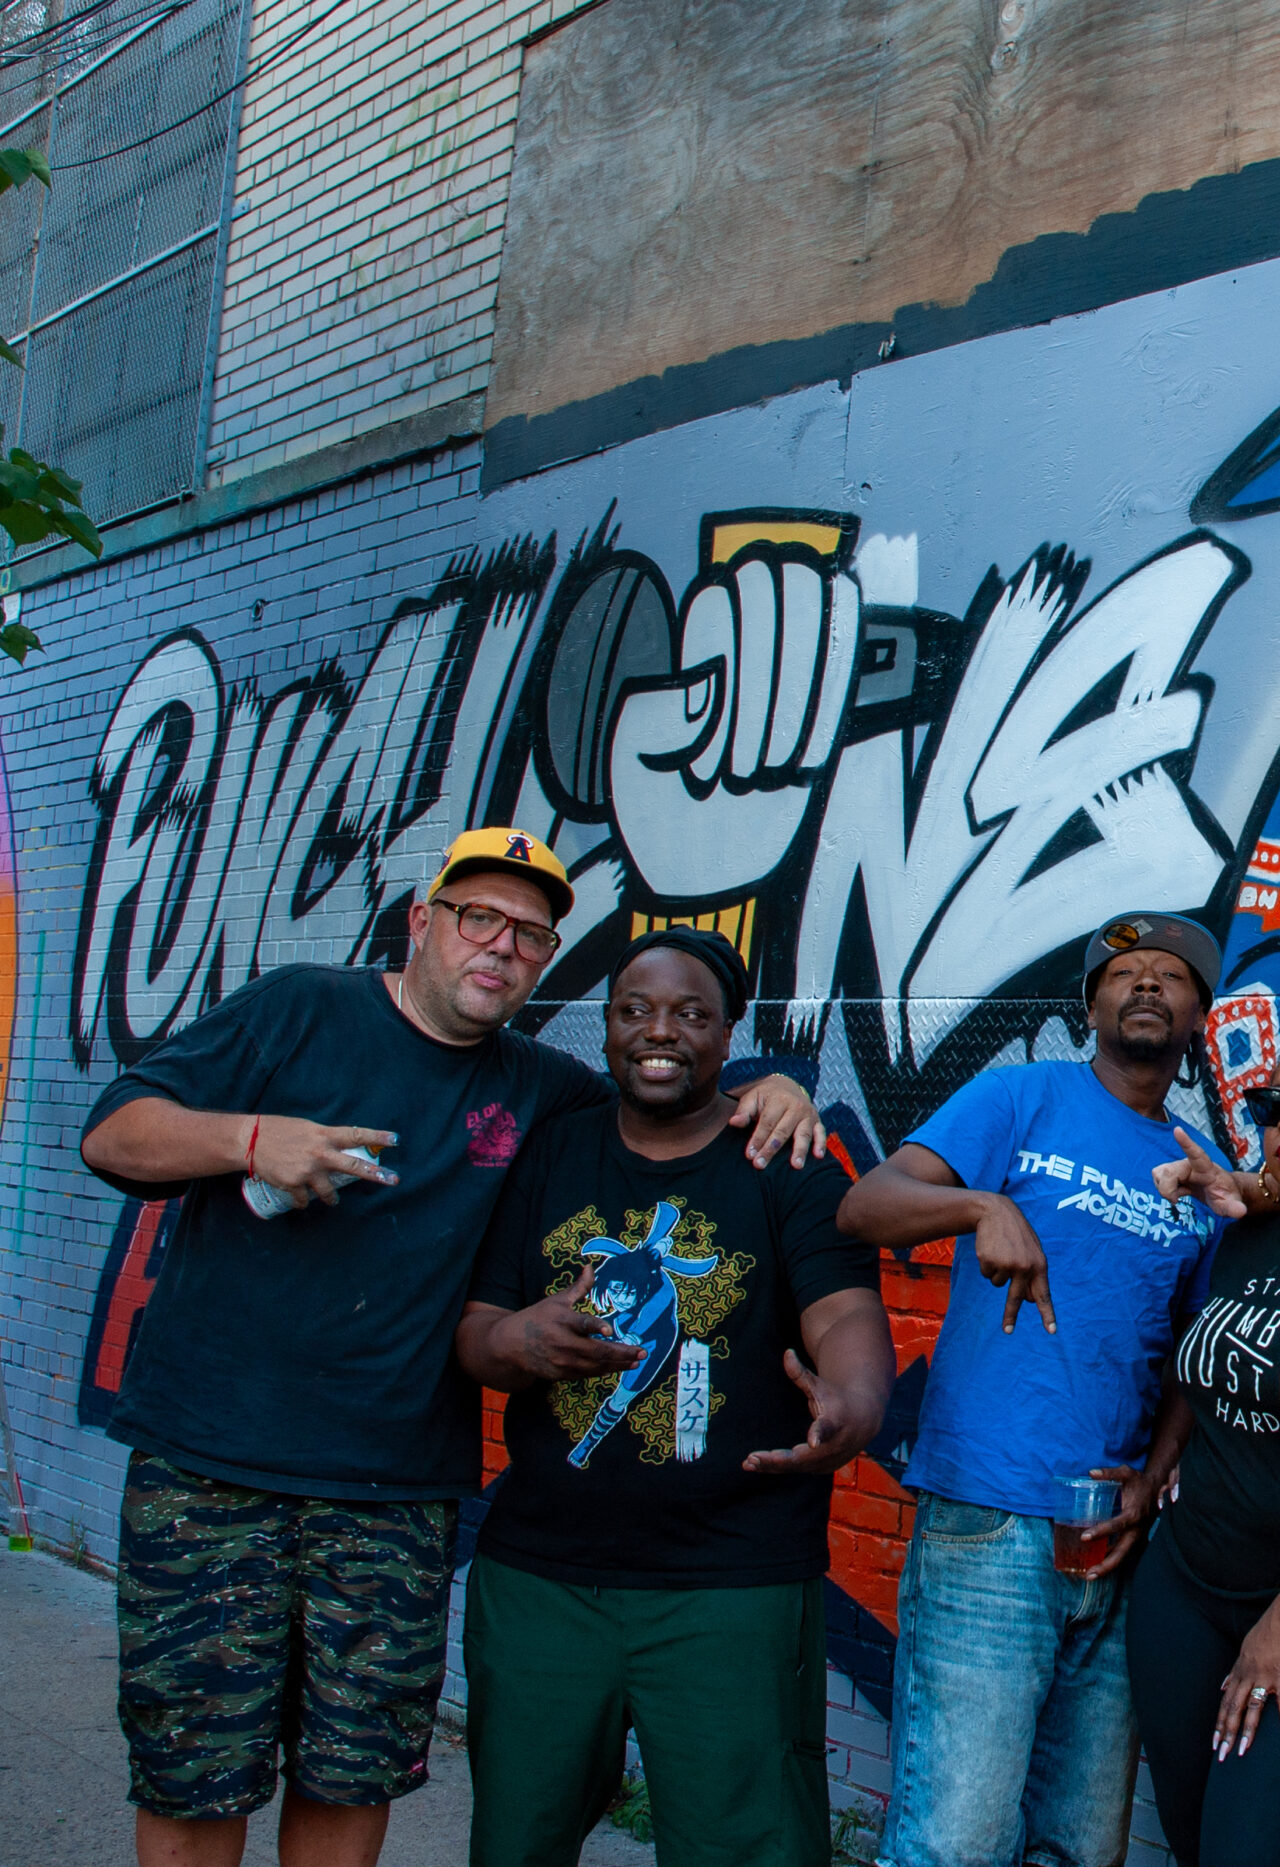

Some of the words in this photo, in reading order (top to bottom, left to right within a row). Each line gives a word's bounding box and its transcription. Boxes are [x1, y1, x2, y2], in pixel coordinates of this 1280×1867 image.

[1017, 1150, 1075, 1181] THE
[1056, 1187, 1182, 1248] ACADEMY
[680, 1360, 707, 1433] サスケ
[1216, 1397, 1280, 1433] HARD
